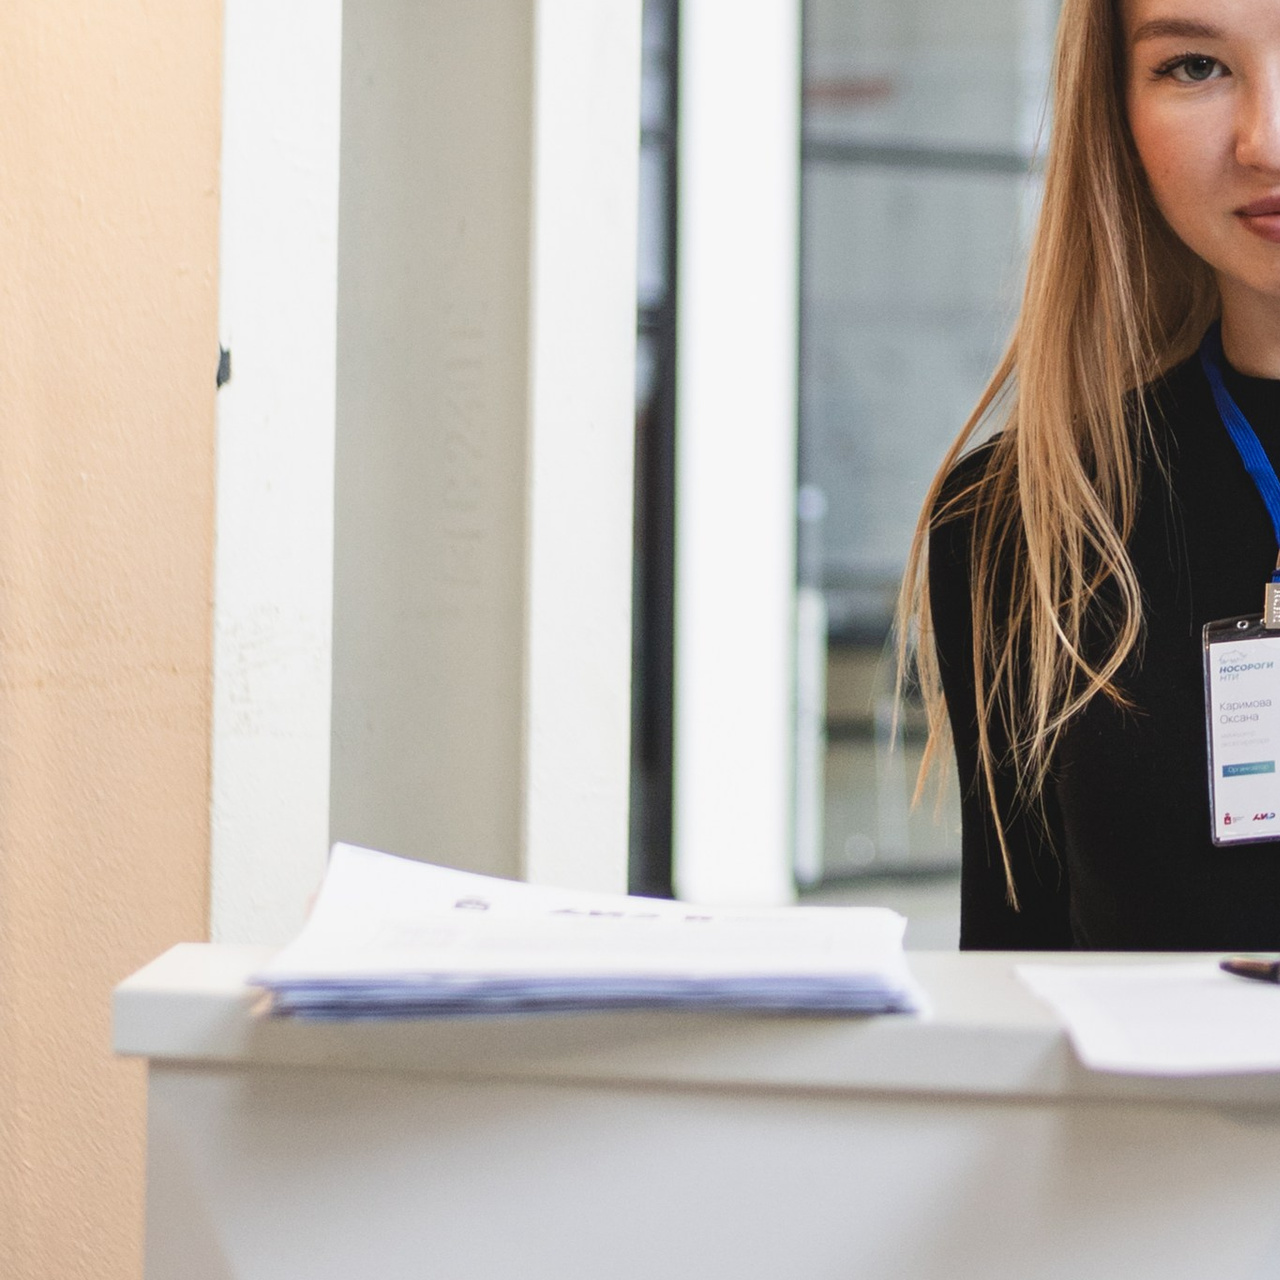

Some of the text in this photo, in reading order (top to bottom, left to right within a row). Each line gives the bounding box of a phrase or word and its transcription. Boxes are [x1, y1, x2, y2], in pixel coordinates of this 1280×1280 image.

[1219, 661, 1274, 674] НОСОРОГИ
[1219, 699, 1272, 712] Каримова
[1219, 713, 1259, 724] Оксана
